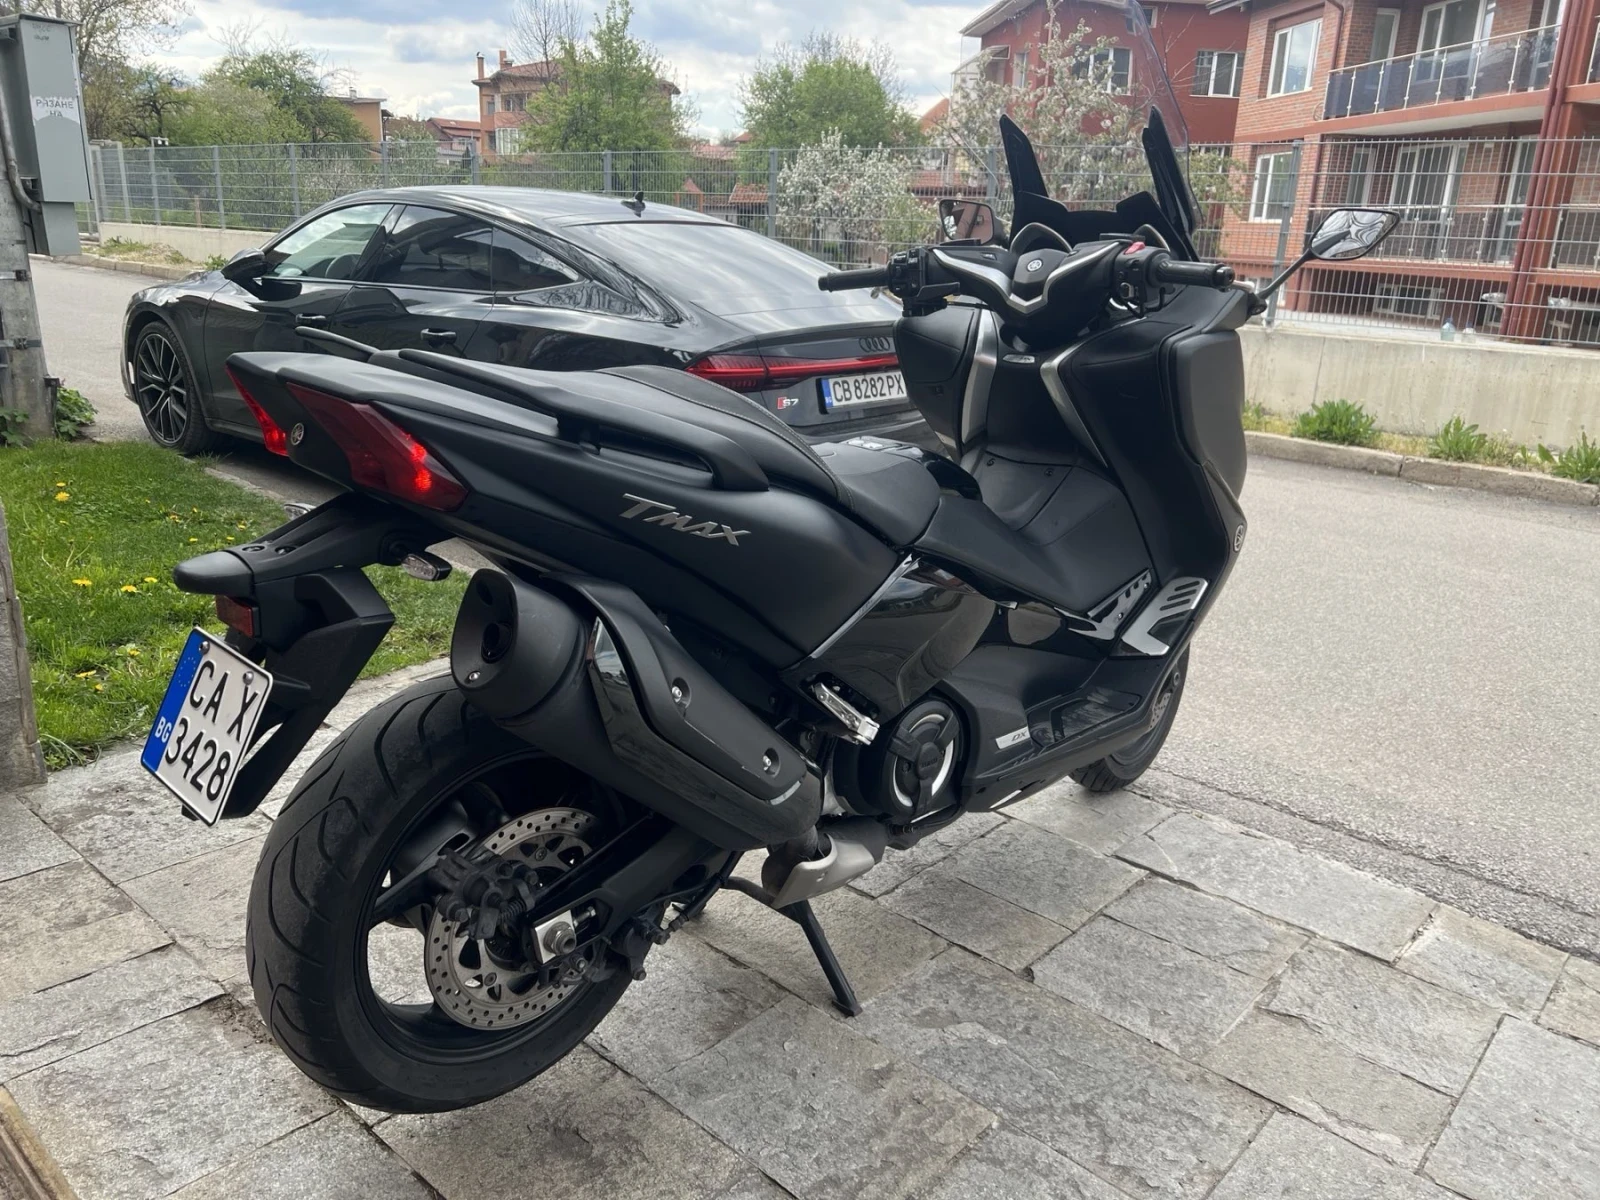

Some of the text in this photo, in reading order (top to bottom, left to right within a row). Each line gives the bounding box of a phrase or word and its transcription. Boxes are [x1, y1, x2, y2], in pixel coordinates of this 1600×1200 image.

[832, 379, 852, 403] CB
[854, 376, 886, 400] 8282
[189, 659, 259, 742] CA X
[155, 716, 172, 743] BG
[165, 717, 232, 801] 3428
